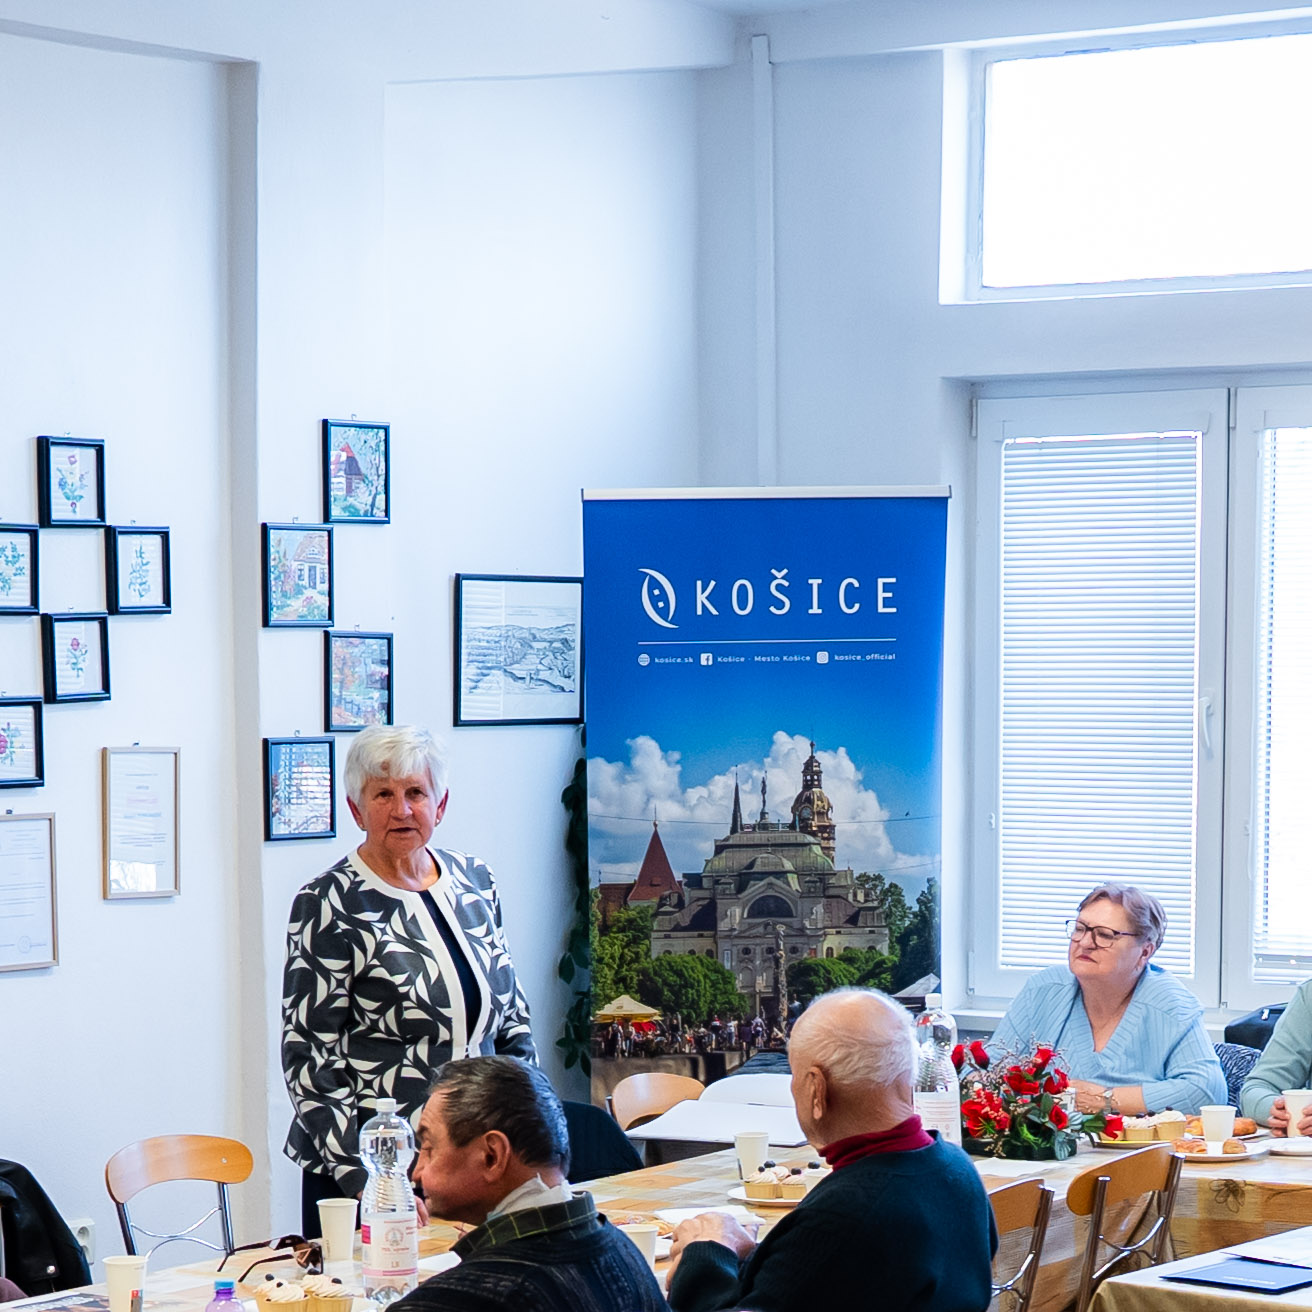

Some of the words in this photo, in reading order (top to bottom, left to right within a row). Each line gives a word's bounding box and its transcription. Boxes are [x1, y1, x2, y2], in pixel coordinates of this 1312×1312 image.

[695, 567, 898, 616] KOŠICE
[754, 654, 781, 663] Mesto
[782, 653, 811, 662] Košice
[834, 652, 896, 662] kosice_official
